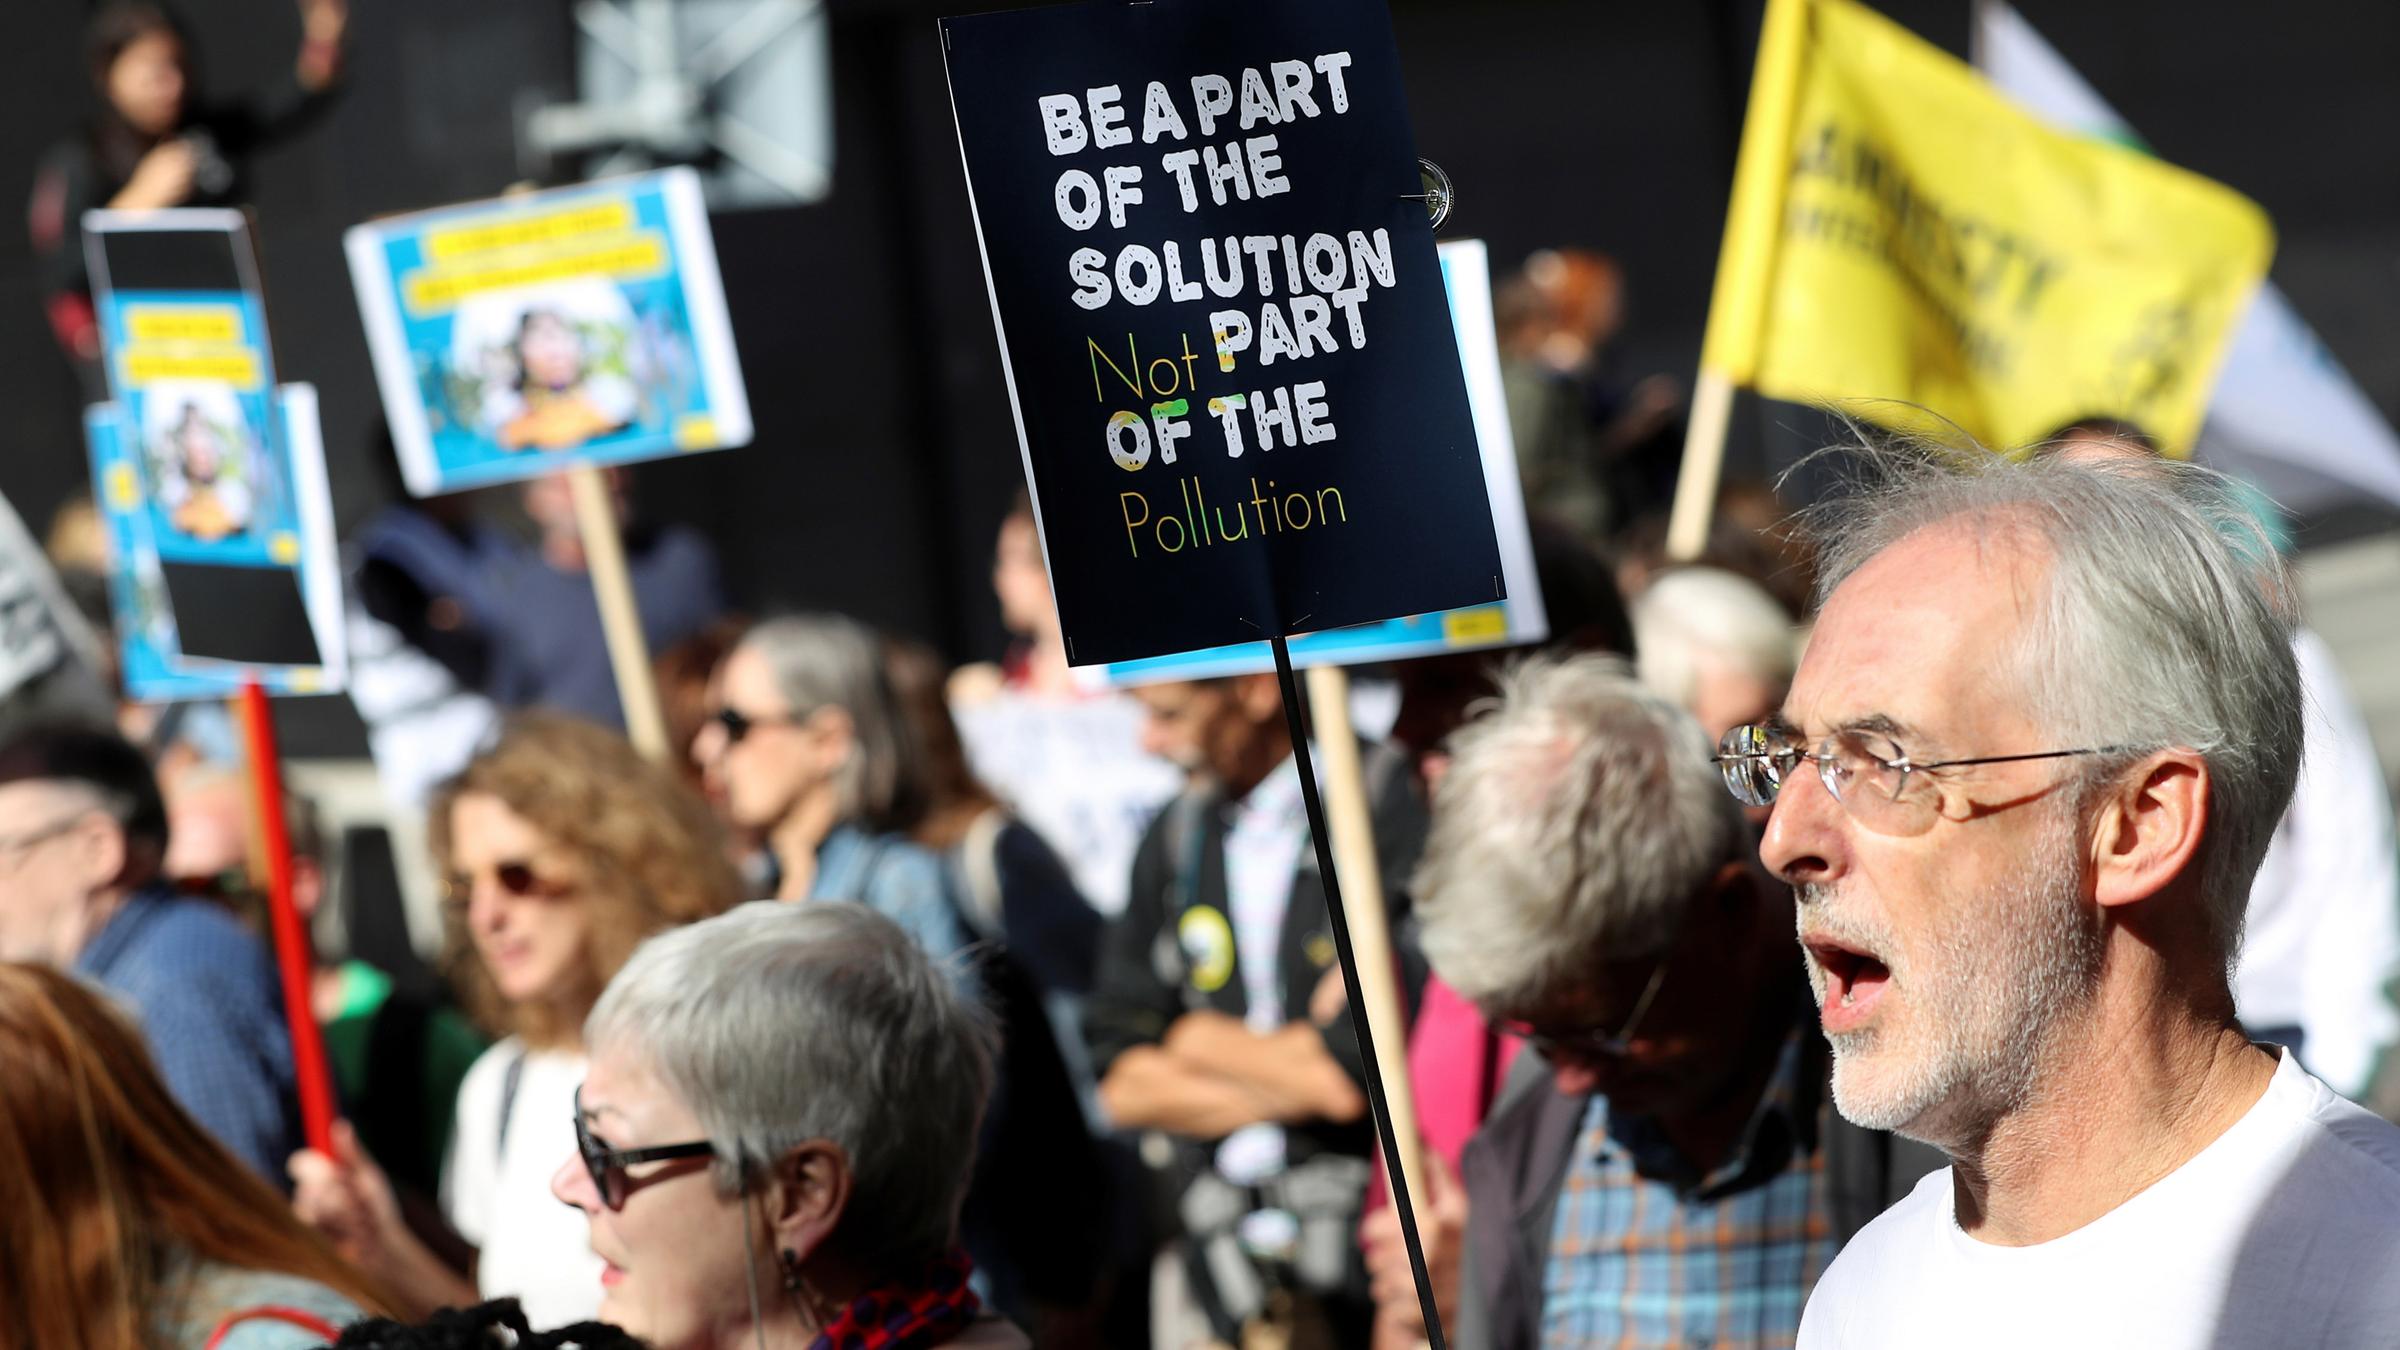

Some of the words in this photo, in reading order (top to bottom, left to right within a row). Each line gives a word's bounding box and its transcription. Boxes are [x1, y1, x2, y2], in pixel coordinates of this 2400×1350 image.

[1039, 84, 1133, 156] BE
[1142, 81, 1187, 143] A
[1191, 52, 1352, 136] PART
[1055, 165, 1143, 230] OF
[1162, 134, 1291, 213] THE
[1069, 228, 1396, 310] SOLUTION
[1087, 332, 1199, 402] Not
[1209, 286, 1368, 372] PART
[1106, 399, 1191, 471] OF
[1208, 380, 1337, 459] THE
[1120, 476, 1346, 558] Pollution
